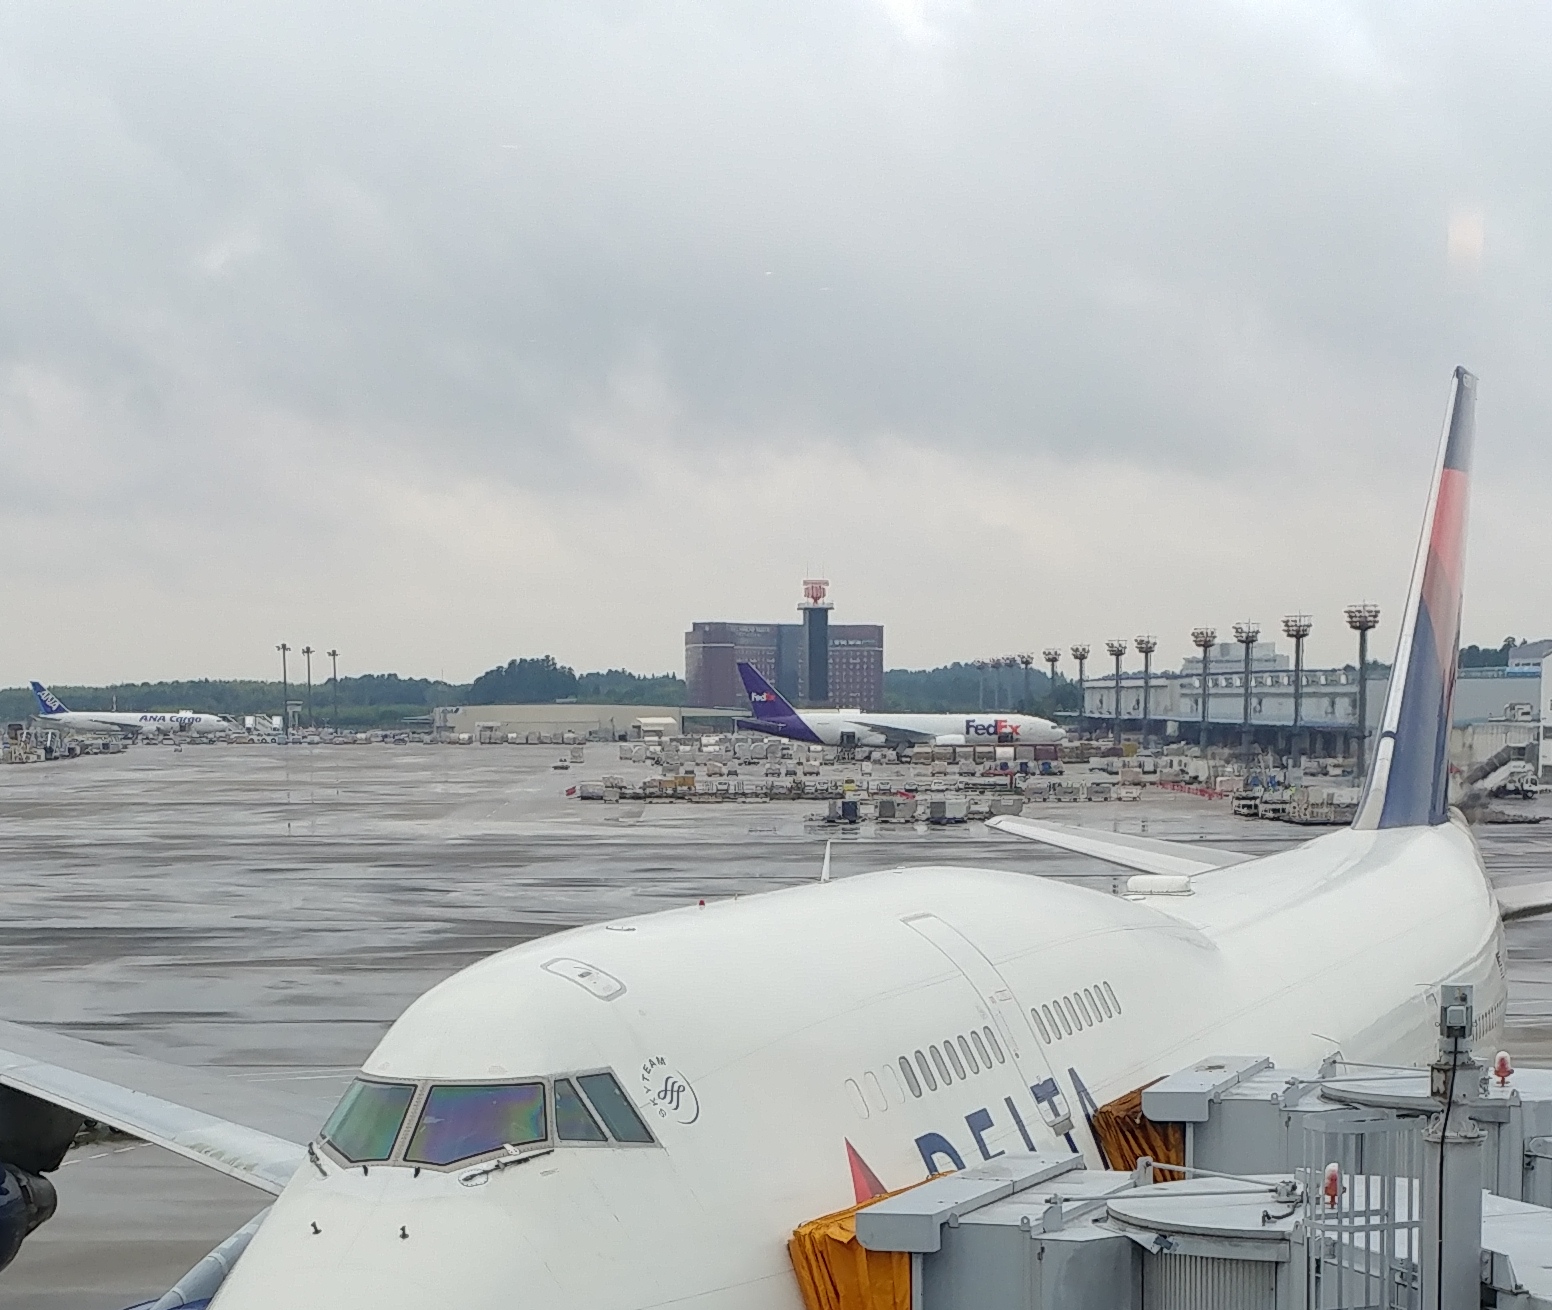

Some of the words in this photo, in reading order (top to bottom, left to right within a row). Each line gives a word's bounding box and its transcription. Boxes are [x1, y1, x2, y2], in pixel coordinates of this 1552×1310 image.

[38, 691, 59, 711] ANA
[139, 715, 166, 723] ANA
[170, 715, 202, 725] Cargo
[965, 719, 1021, 736] FedEx
[641, 1056, 667, 1118] SKYTEAM
[914, 1068, 1109, 1177] DELTA
